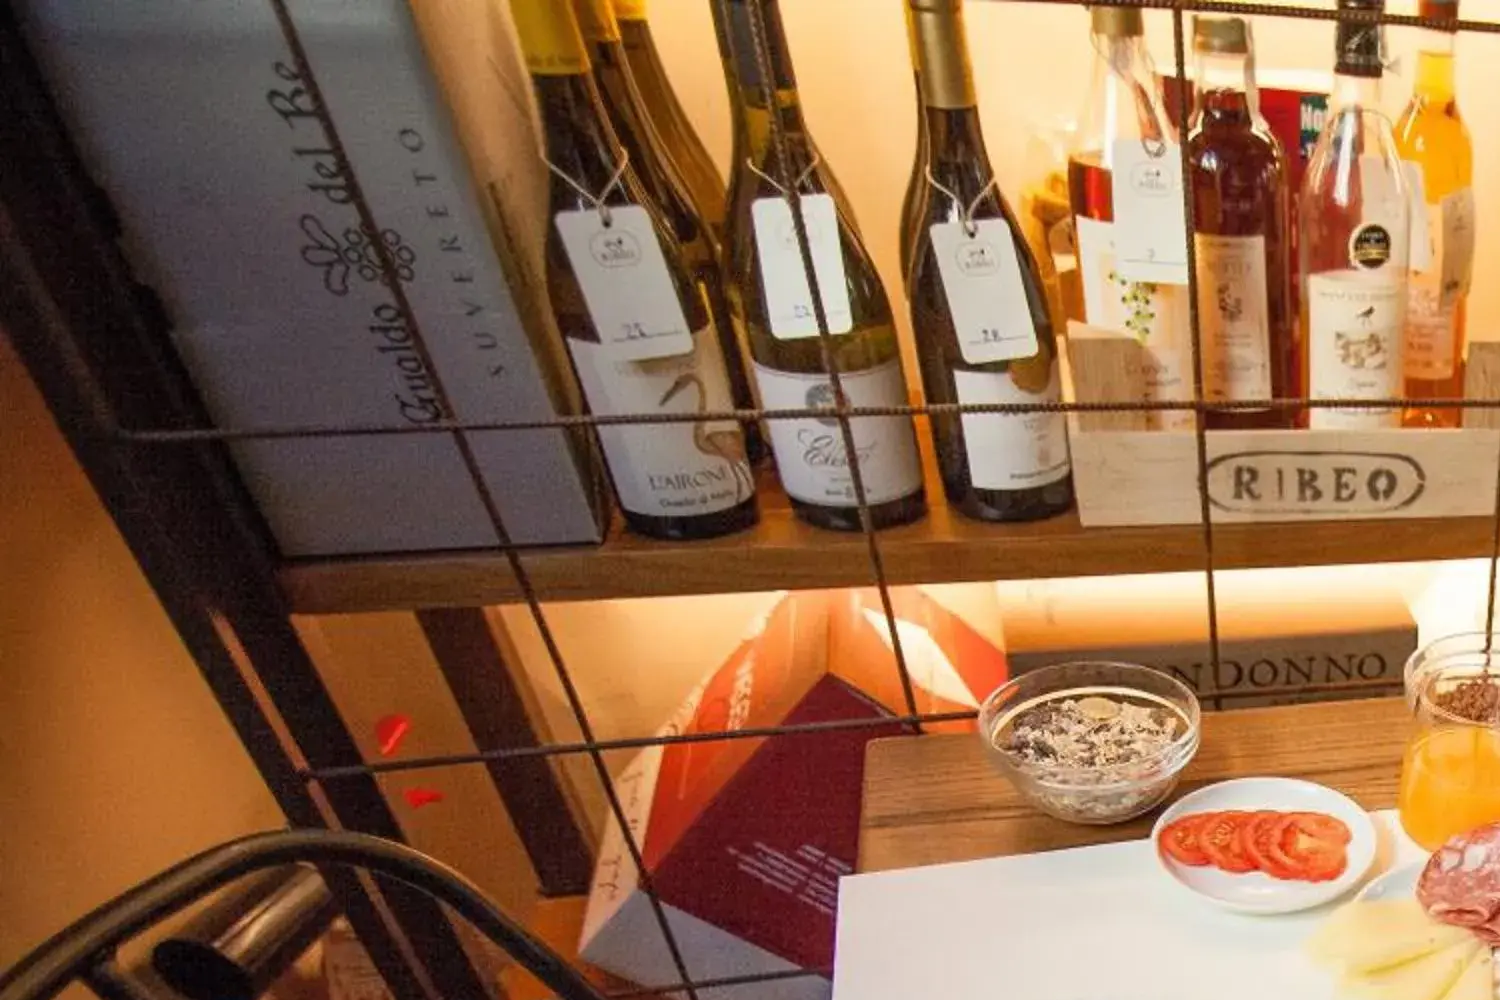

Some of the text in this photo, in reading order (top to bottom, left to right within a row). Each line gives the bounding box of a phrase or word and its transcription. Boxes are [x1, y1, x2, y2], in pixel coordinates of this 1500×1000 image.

[266, 61, 324, 130] Re
[292, 147, 356, 206] del
[398, 127, 506, 377] SUVERETO
[1232, 464, 1399, 503] RIBEO
